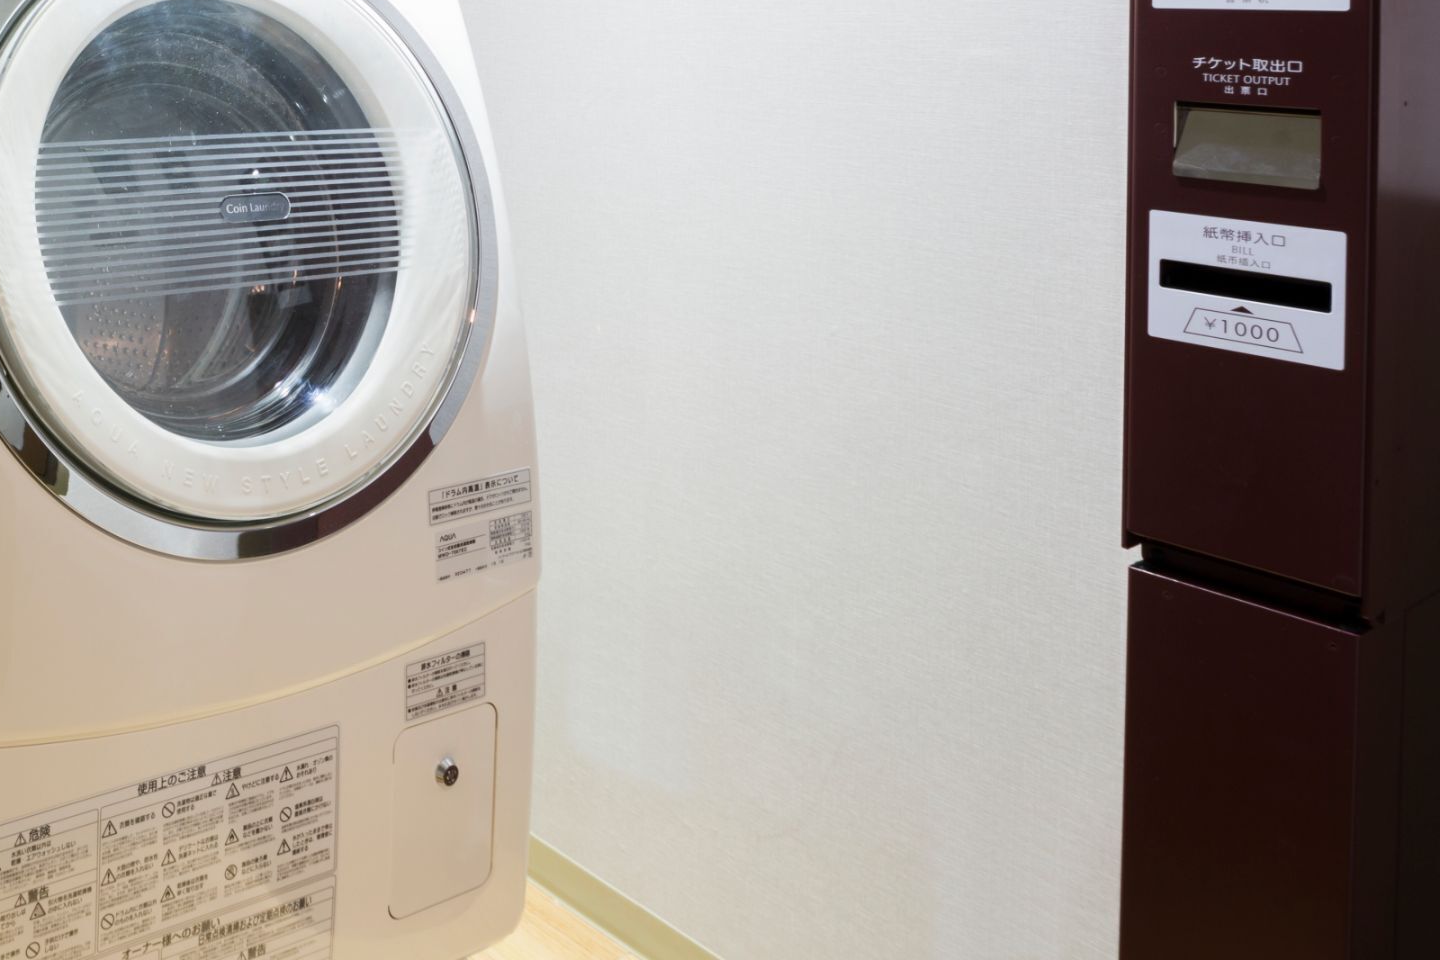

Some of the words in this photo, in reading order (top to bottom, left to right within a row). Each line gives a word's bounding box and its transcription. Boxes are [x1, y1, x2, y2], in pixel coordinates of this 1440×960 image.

[1192, 56, 1304, 74] チケット取出口
[1203, 72, 1240, 84] TICKET
[1243, 75, 1292, 86] OUTPUT
[225, 203, 248, 214] Coin
[1202, 226, 1286, 247] 紙幣挿入口
[1231, 245, 1255, 256] BILL
[1204, 316, 1280, 342] ¥1000
[137, 764, 207, 797] 使用上のご注意
[222, 767, 243, 783] 注意
[28, 824, 51, 843] 危険
[27, 885, 49, 903] 警告
